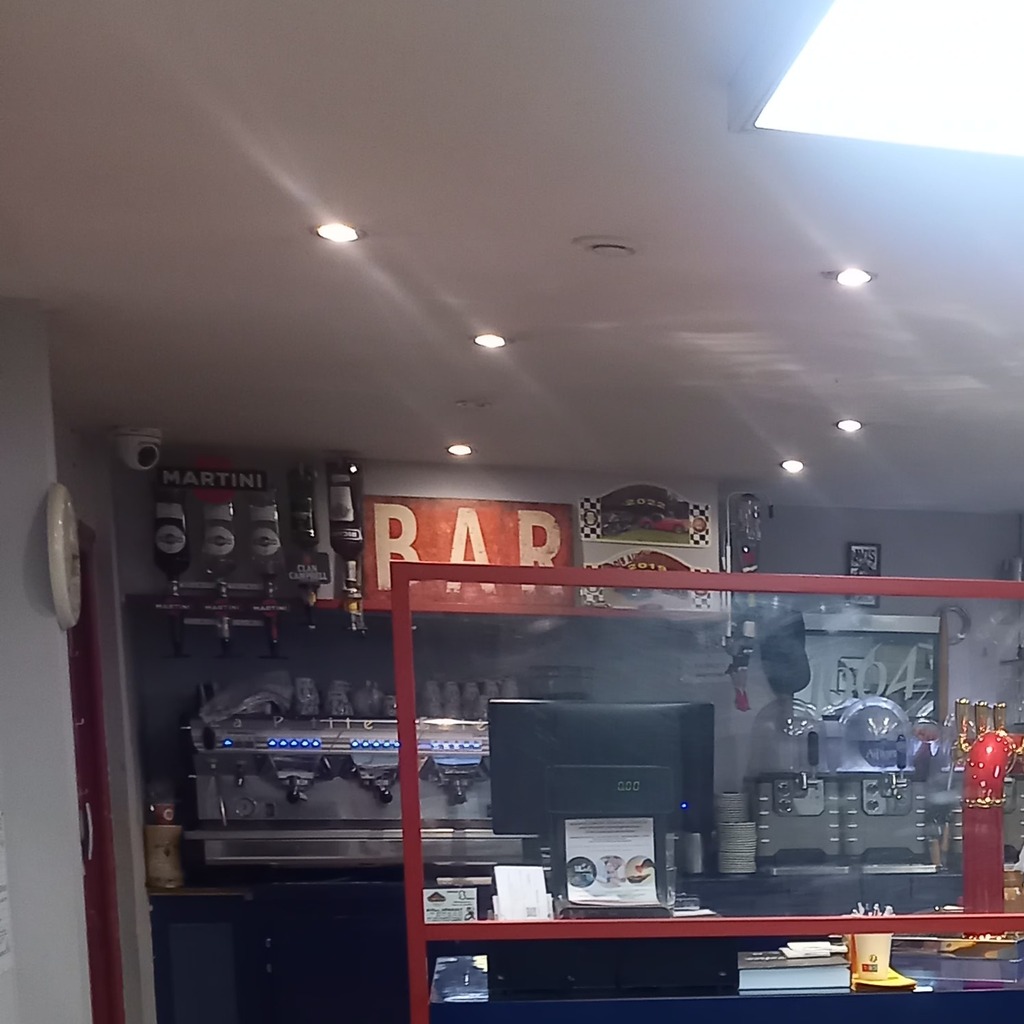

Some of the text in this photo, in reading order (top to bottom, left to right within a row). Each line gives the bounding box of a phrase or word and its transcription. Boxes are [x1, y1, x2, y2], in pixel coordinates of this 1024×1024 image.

[162, 469, 265, 489] MARTINI
[373, 503, 565, 594] BAR
[297, 564, 318, 573] CLAN
